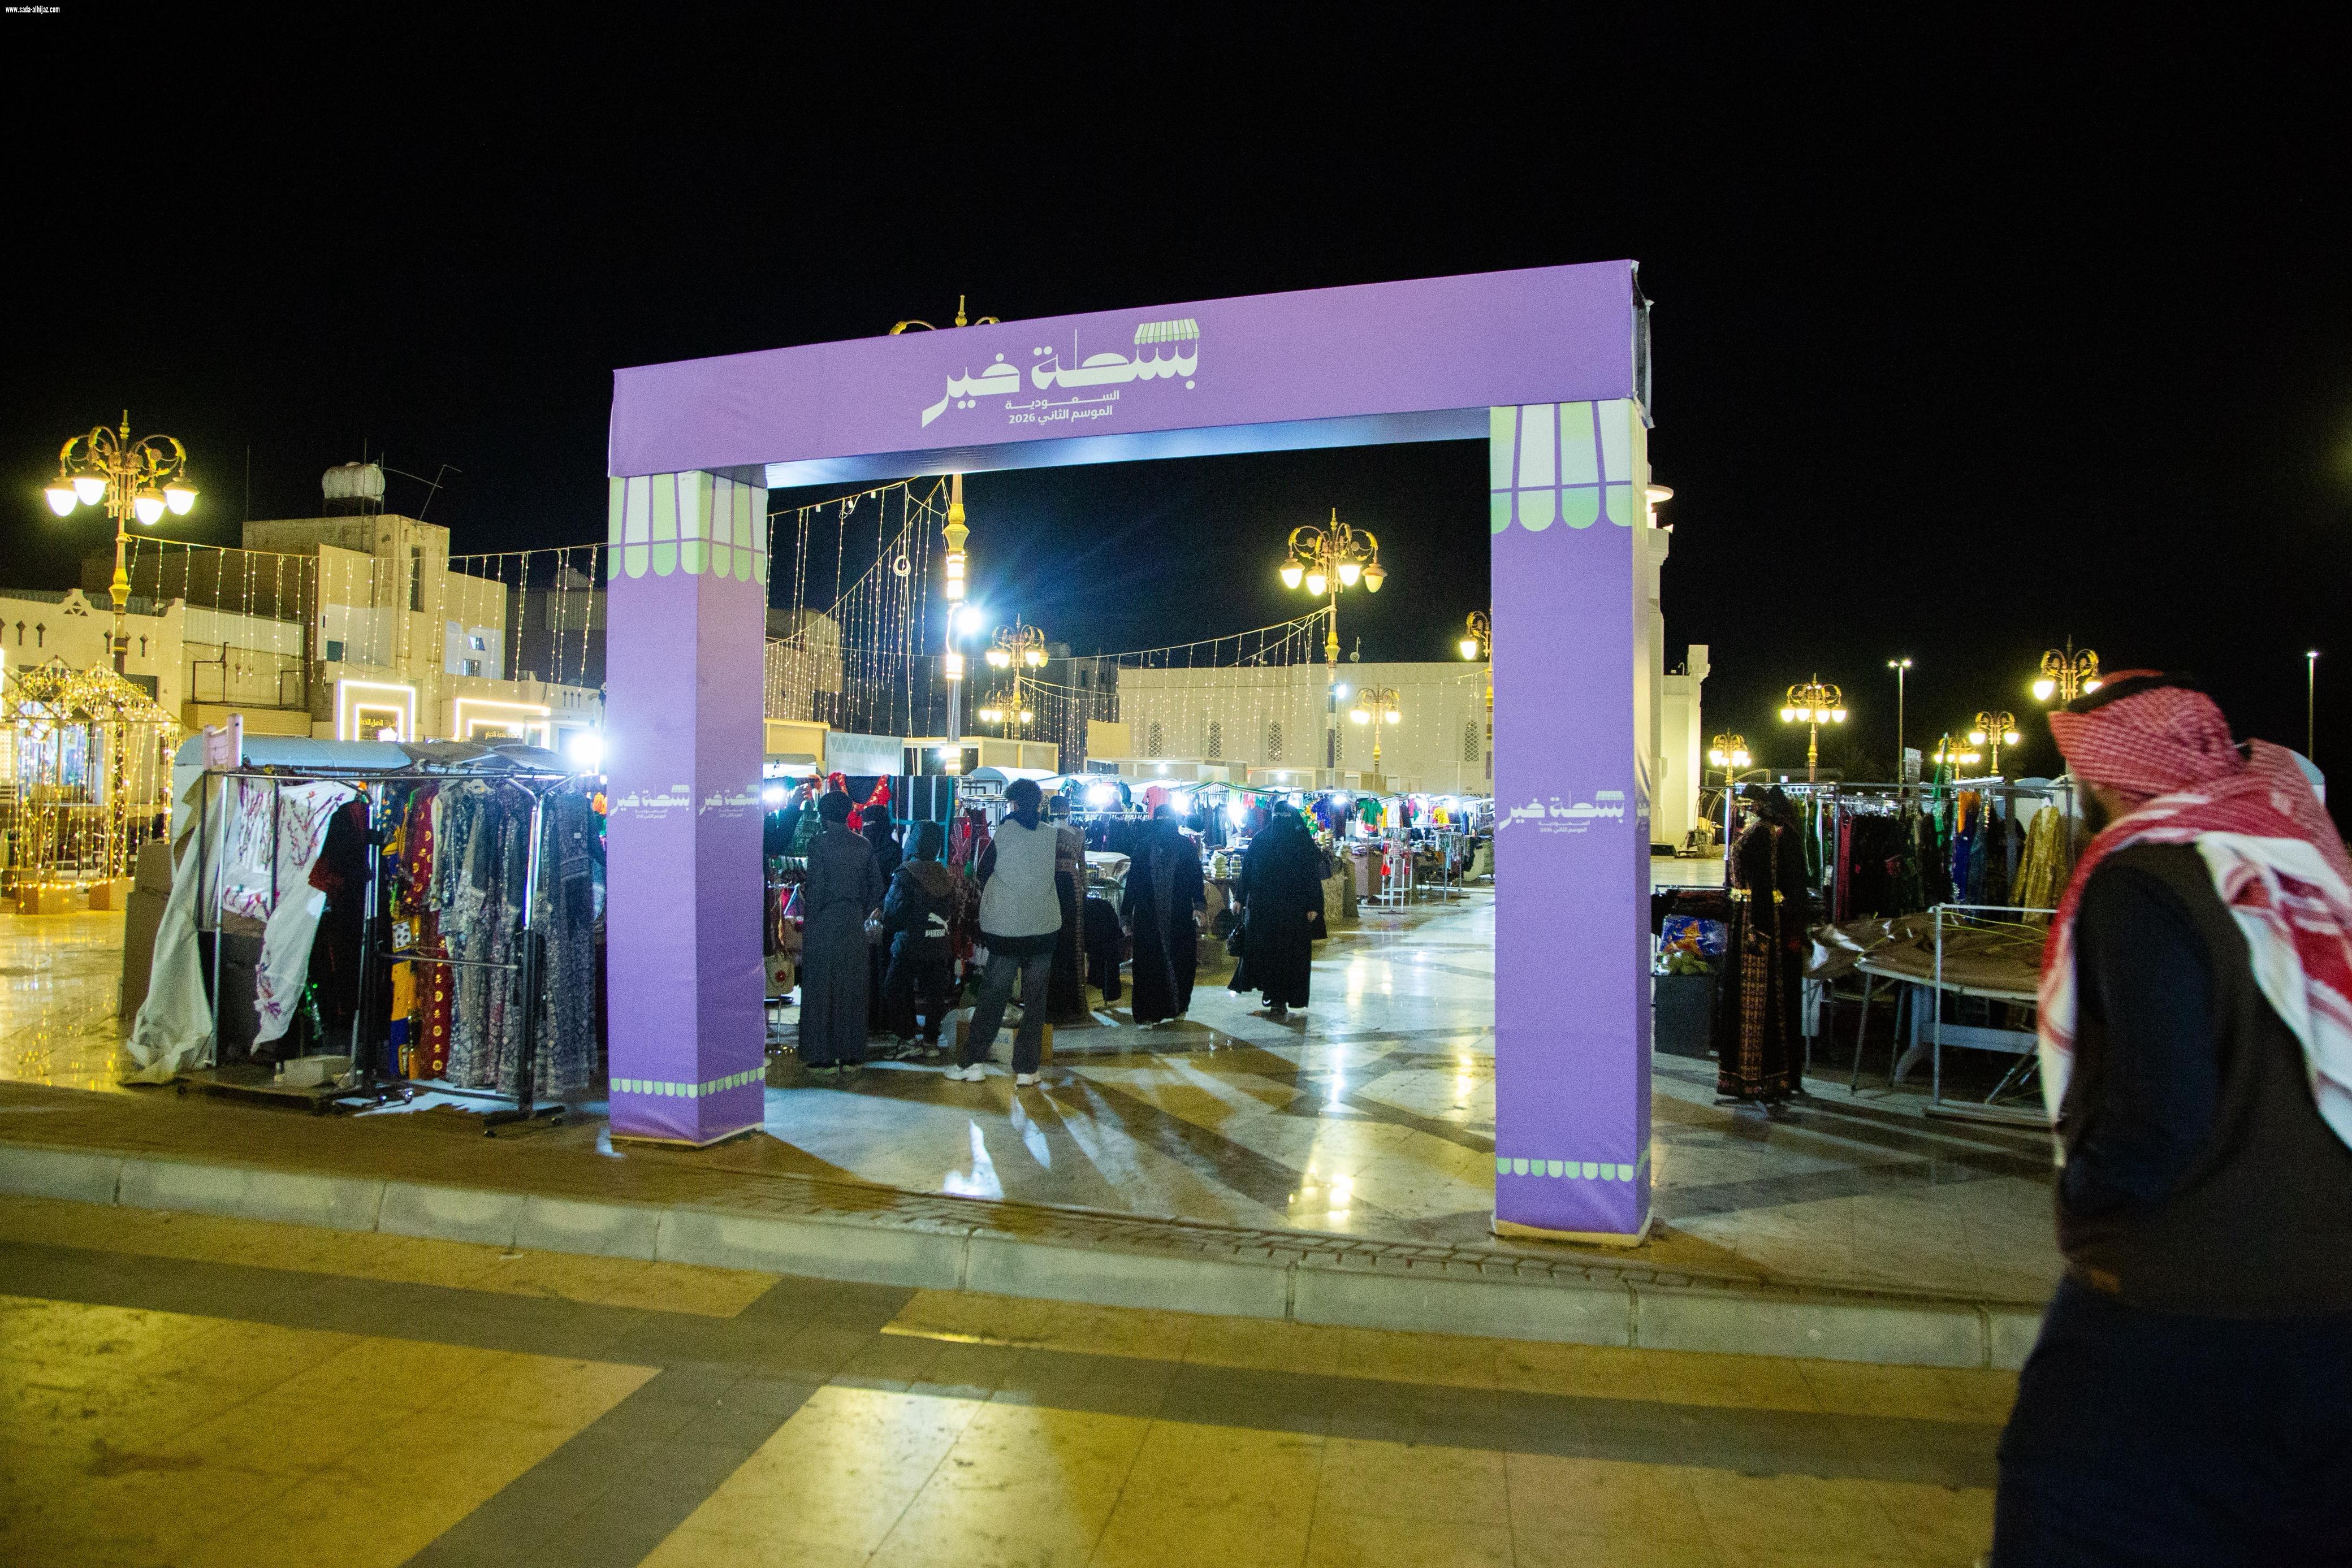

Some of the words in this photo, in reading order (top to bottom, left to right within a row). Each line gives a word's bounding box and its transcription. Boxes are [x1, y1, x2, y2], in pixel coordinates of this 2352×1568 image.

[1031, 329, 1197, 390] بسطة
[922, 353, 1020, 428] خير
[1009, 413, 1036, 424] 2026
[1037, 409, 1069, 425] الثاني
[1071, 405, 1113, 422] الموسم
[609, 791, 640, 817] خير
[1498, 798, 1545, 831] خير
[1549, 791, 1624, 824] بسطة
